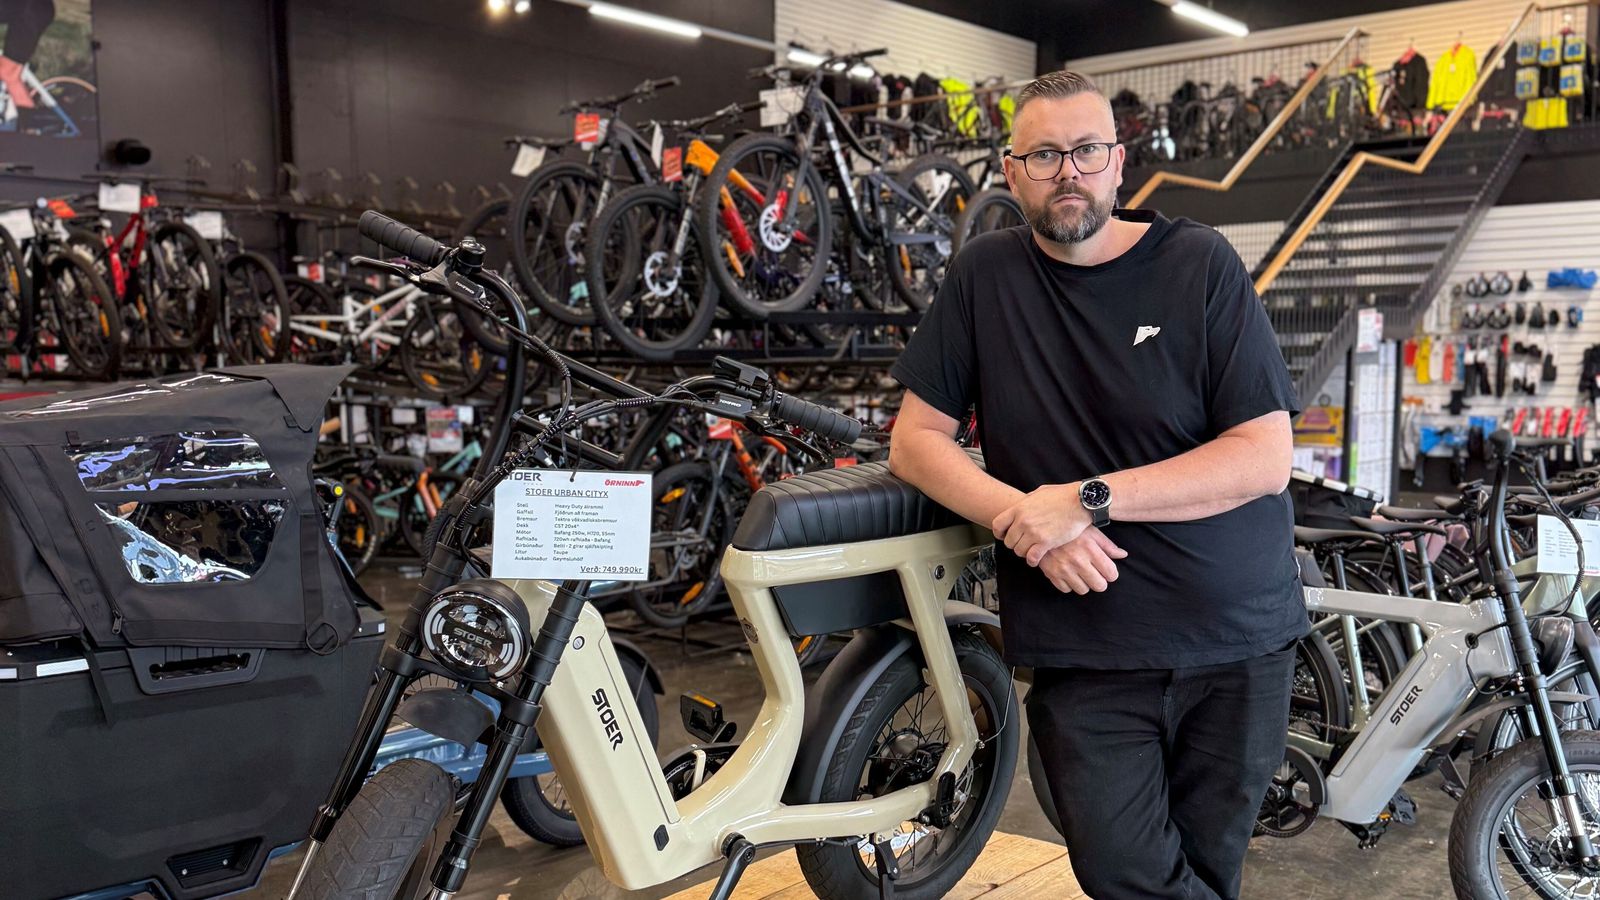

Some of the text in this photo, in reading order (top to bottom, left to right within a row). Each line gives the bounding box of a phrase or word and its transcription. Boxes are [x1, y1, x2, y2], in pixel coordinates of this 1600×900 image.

[503, 472, 542, 481] TOER
[602, 566, 643, 574] 749.990kr
[453, 627, 492, 649] STOER
[1390, 685, 1423, 726] STOER
[591, 688, 624, 752] STOER
